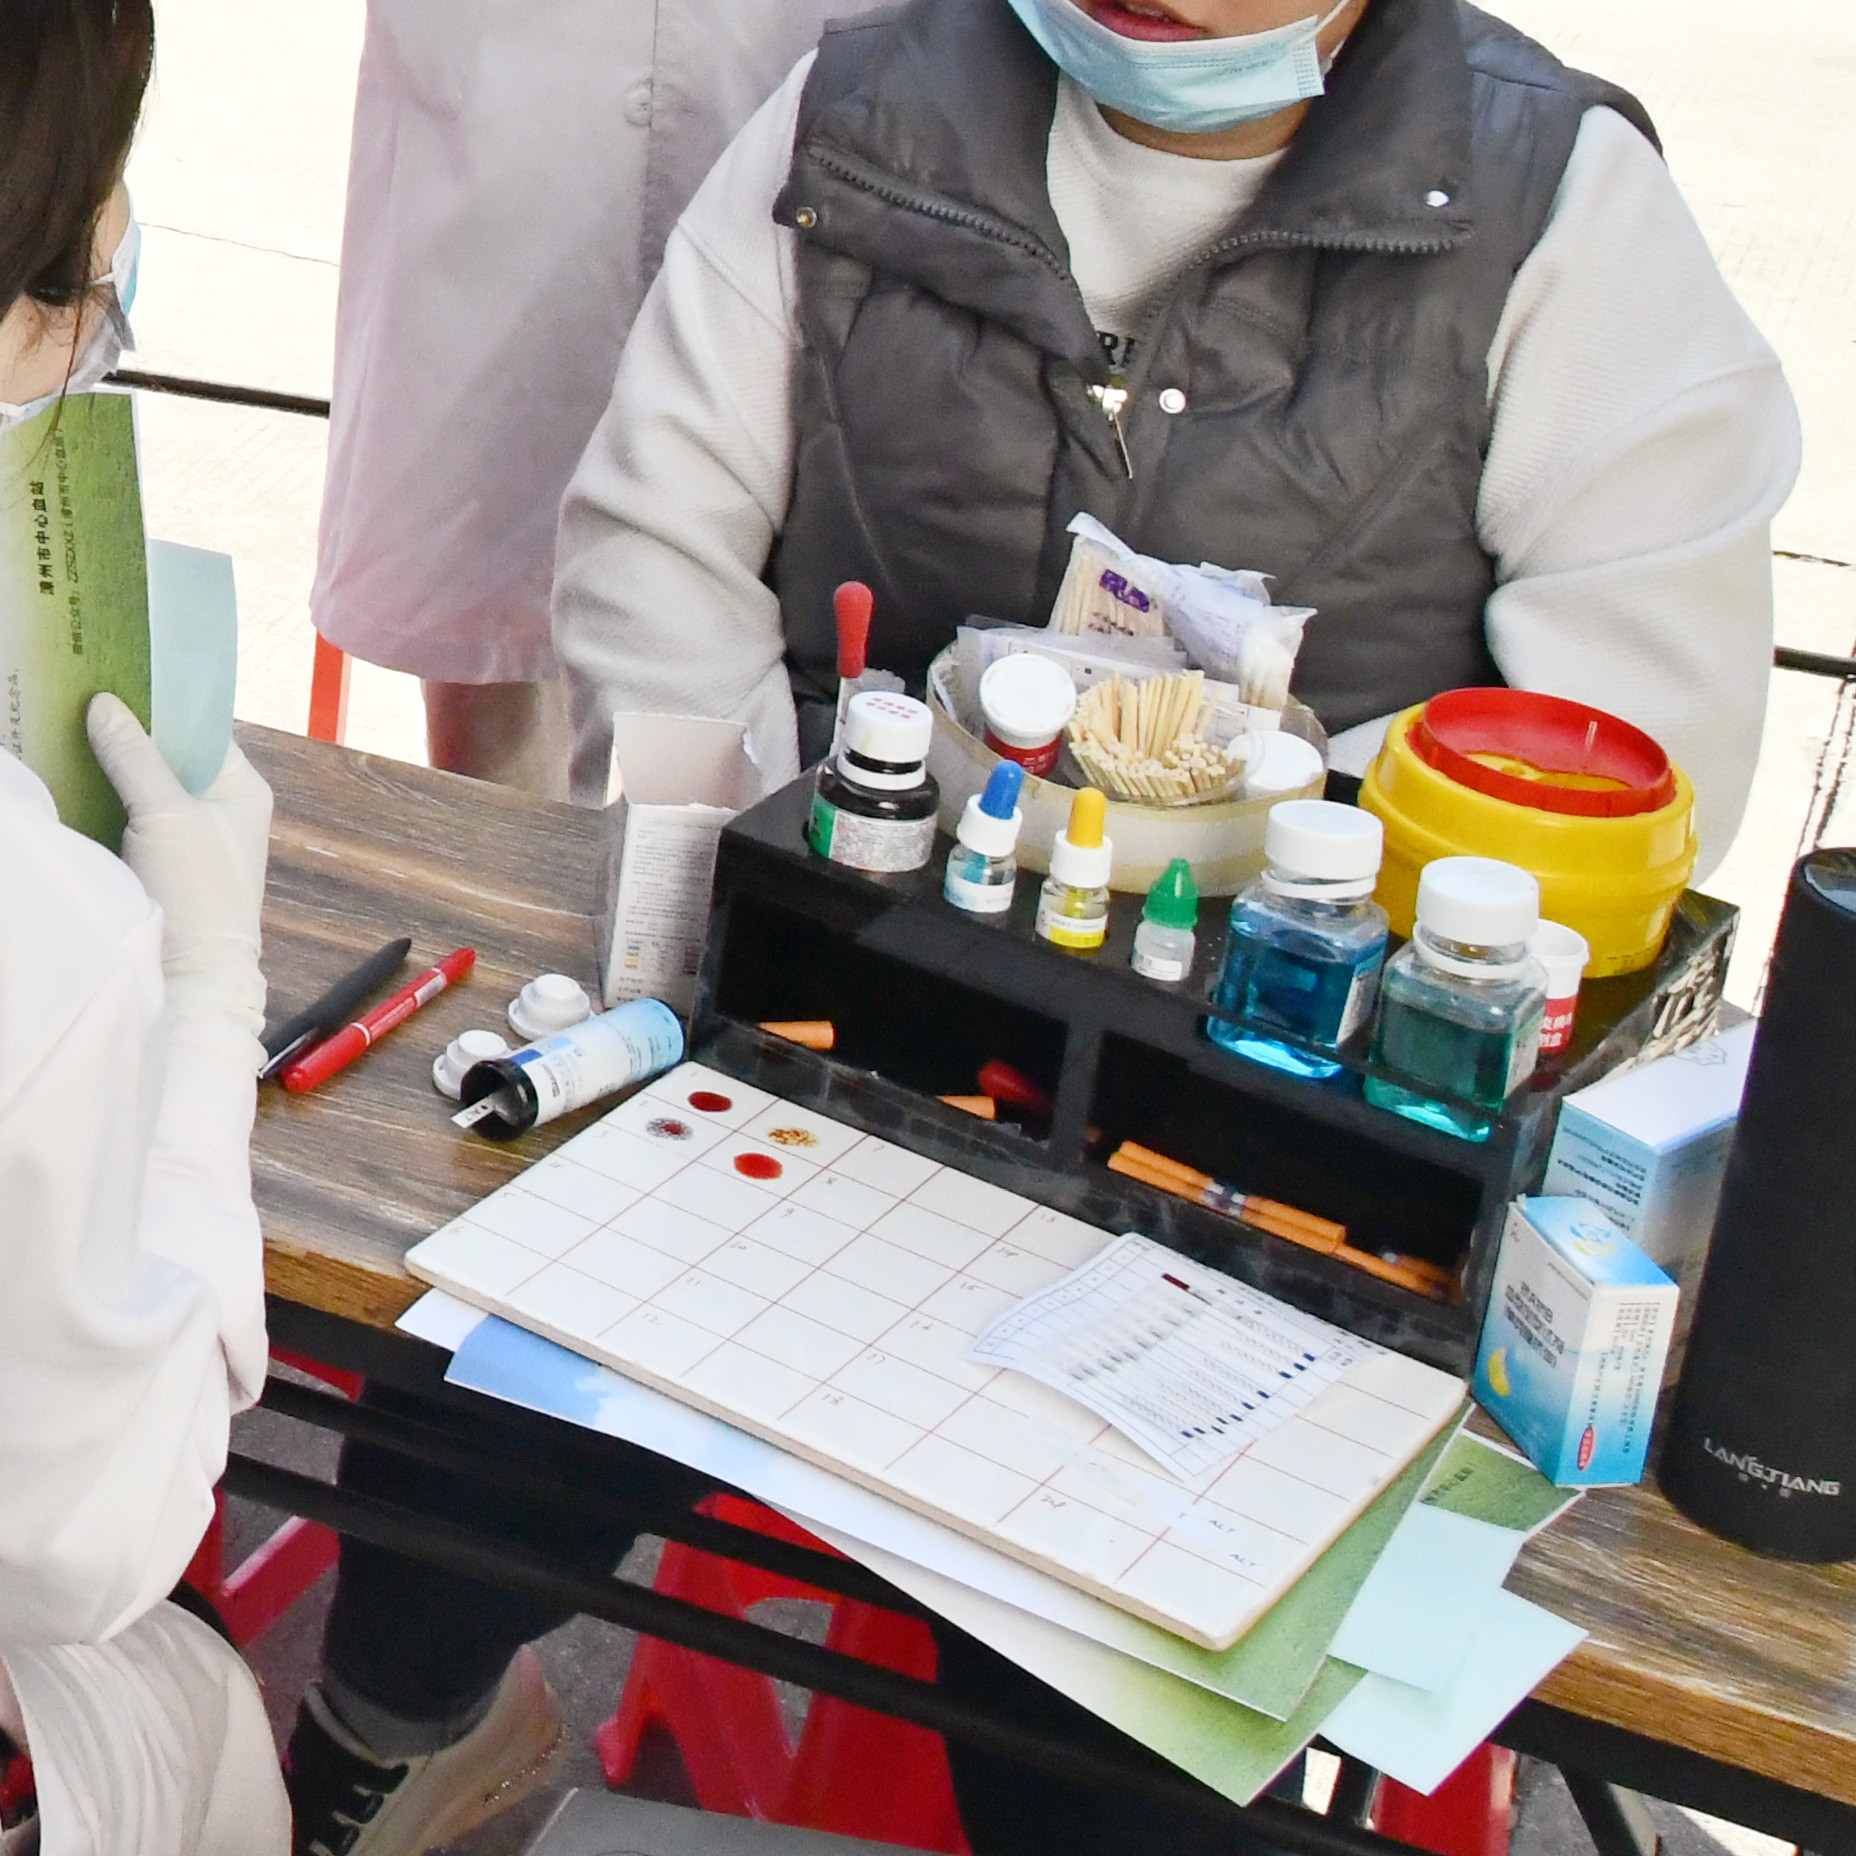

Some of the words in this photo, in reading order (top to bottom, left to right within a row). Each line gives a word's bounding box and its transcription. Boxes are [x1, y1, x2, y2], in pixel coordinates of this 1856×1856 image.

[31, 479, 56, 597] 漳州市中心血站
[1703, 1436, 1841, 1497] LANGJIANG
